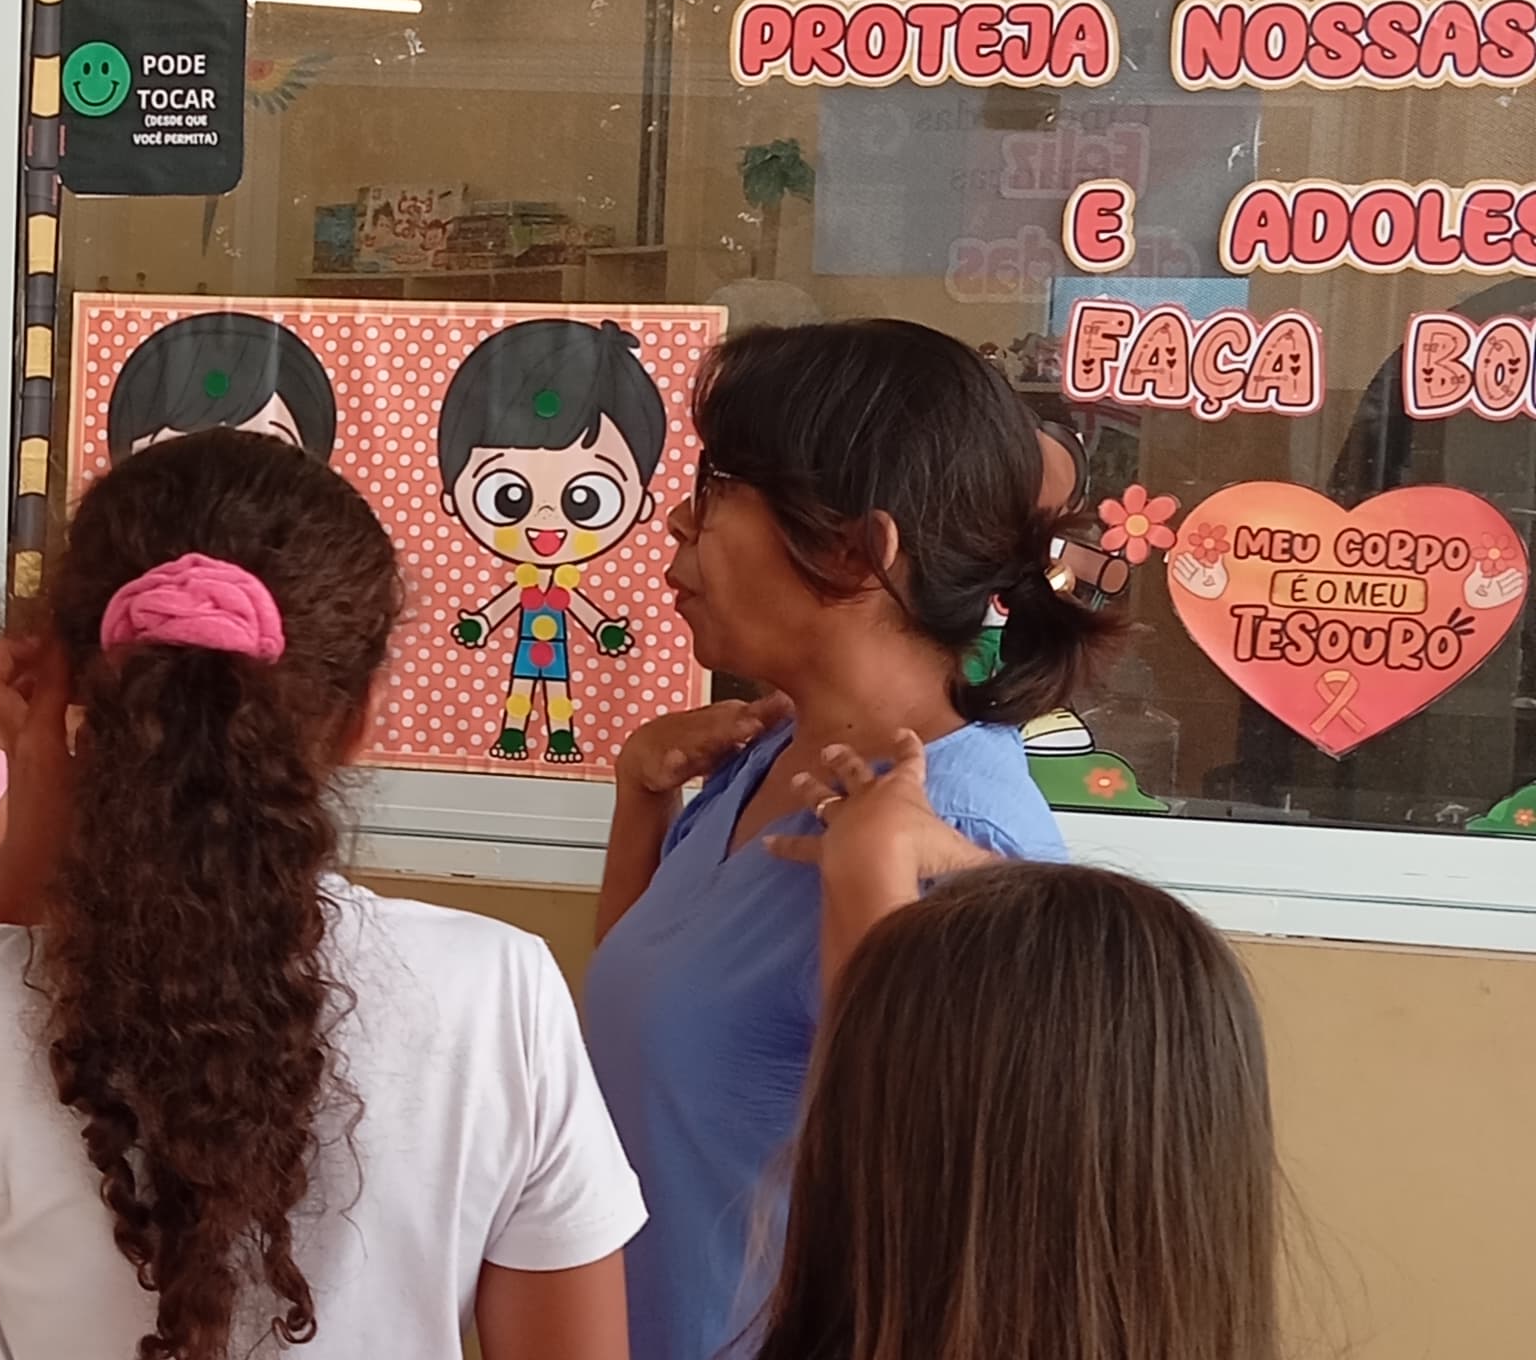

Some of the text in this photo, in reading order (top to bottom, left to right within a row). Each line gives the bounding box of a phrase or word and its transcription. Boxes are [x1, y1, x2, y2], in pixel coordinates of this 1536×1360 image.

[739, 2, 1536, 79] PROTEJA NOSSAS
[143, 54, 206, 76] PODE
[137, 89, 216, 110] TOCAR
[133, 132, 219, 145] VOCÊ PERMITA)
[144, 114, 208, 128] (DESDE QUE
[1073, 188, 1125, 263] E
[1072, 306, 1536, 415] FAÇA BO
[1233, 526, 1471, 575] MEU CORPO
[1290, 575, 1408, 608] É O MEU
[1230, 604, 1463, 671] TESOURO
